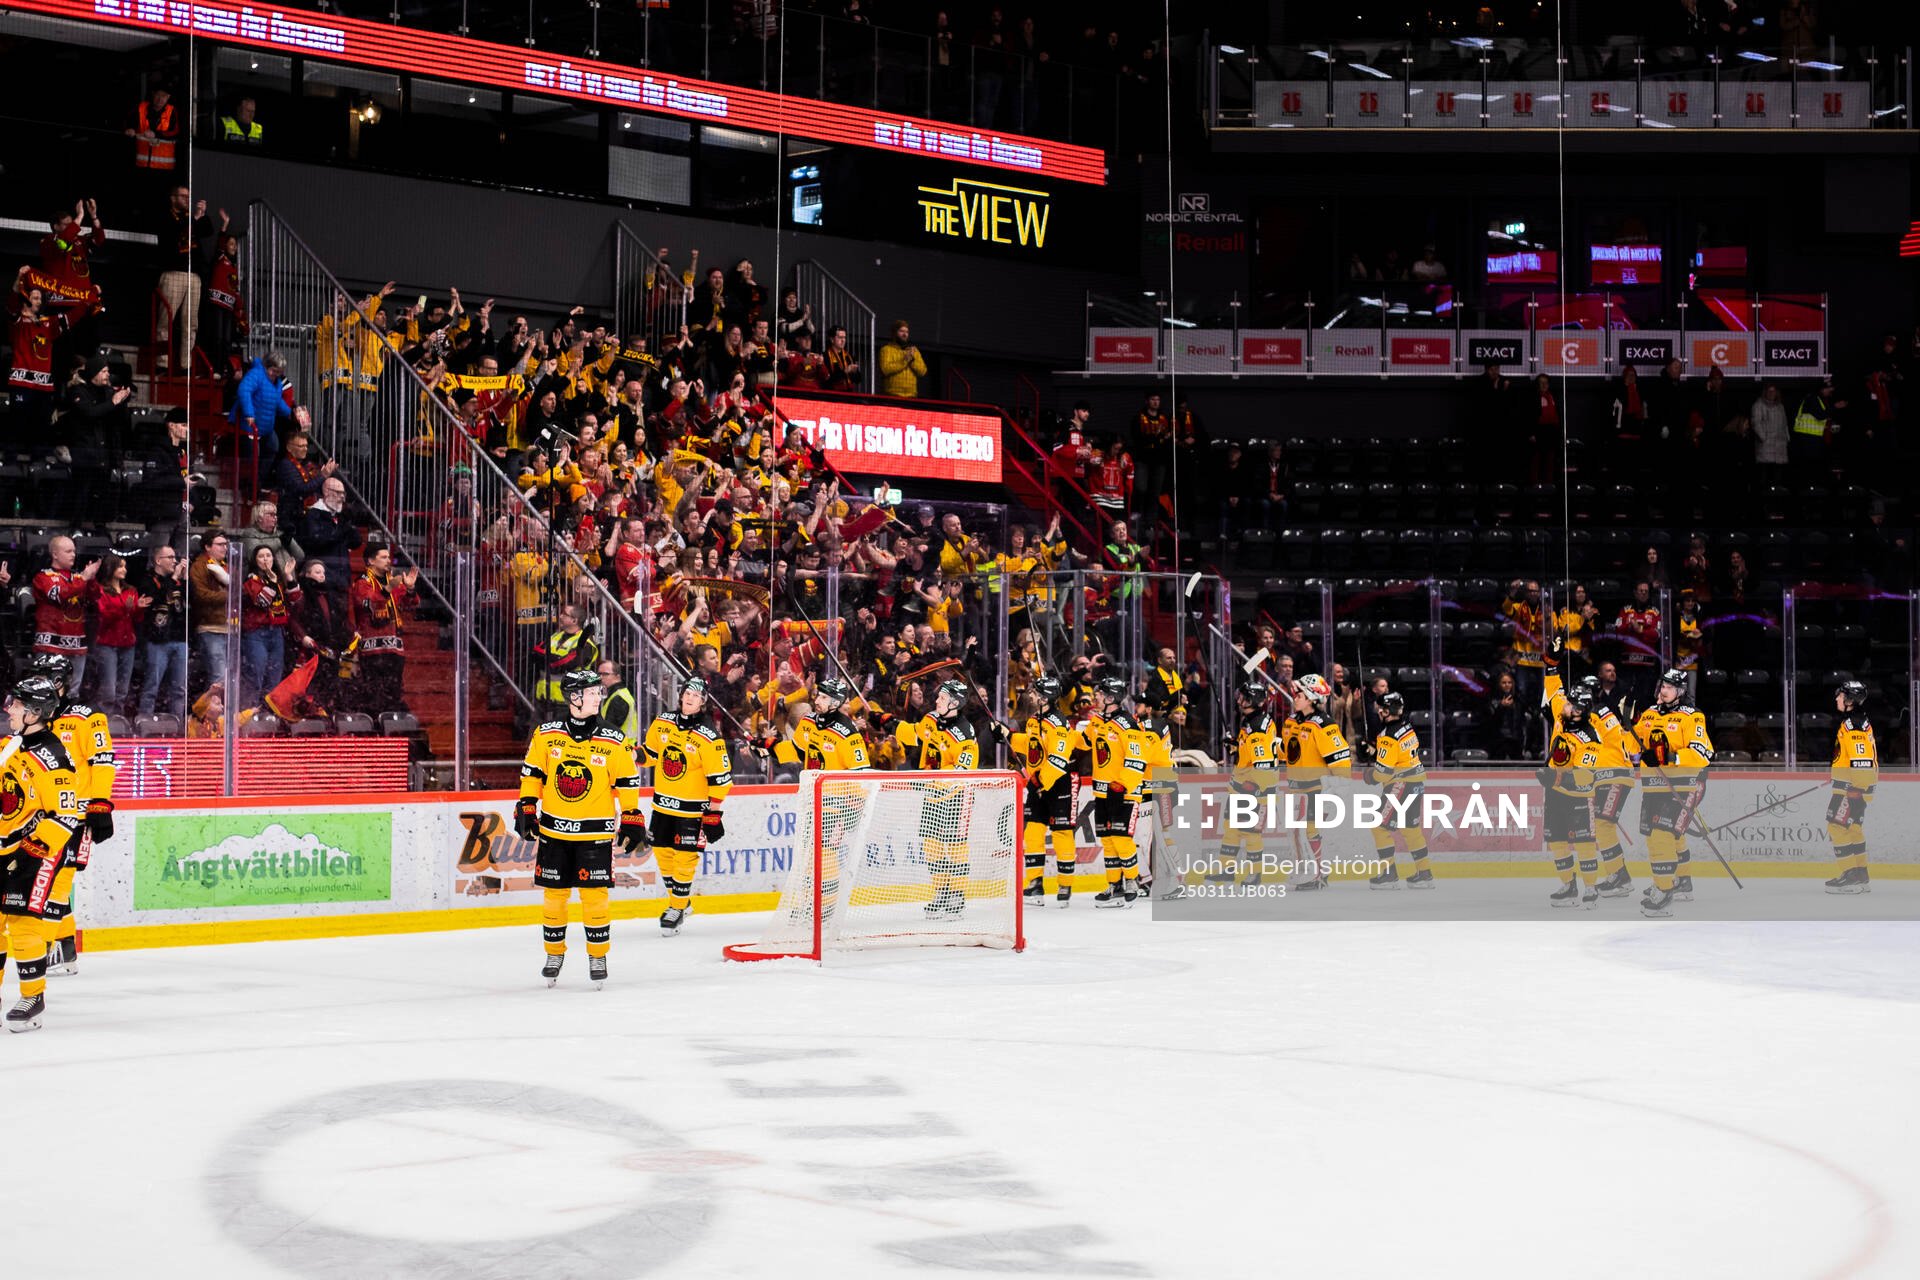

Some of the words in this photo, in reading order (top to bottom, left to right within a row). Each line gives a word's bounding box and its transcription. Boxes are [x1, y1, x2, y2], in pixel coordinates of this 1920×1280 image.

[1181, 195, 1208, 210] NR
[918, 200, 959, 236] THE
[959, 190, 1049, 248] VIEW
[1146, 213, 1191, 222] NORDIC
[1195, 213, 1244, 222] RENTAL
[1176, 231, 1245, 252] Renall
[1187, 345, 1226, 357] Renall
[1335, 345, 1375, 357] Renall
[1475, 347, 1516, 359] EXACT
[1625, 347, 1666, 359] EXACT
[1771, 348, 1812, 360] EXACT
[844, 423, 863, 452] VI
[864, 425, 903, 455] SOM
[931, 427, 994, 462] ÖREBRO
[72, 704, 91, 716] SSAB
[540, 721, 563, 731] SSAB
[698, 725, 717, 739] SSAB
[833, 722, 851, 736] SSAB
[601, 727, 624, 741] SSAB
[951, 726, 966, 742] SSAB
[1057, 741, 1065, 753] 3
[1129, 742, 1141, 755] 40
[1254, 746, 1265, 757] 86
[1379, 747, 1387, 759] 10
[1856, 743, 1865, 755] 15
[37, 747, 59, 770] SSAB
[958, 751, 973, 766] 96
[1582, 753, 1597, 767] 24
[1596, 770, 1614, 779] SSAB
[60, 792, 75, 809] 23
[659, 796, 681, 809] SSAB
[554, 820, 581, 832] SSAB
[1701, 823, 1833, 843] INGSTRÖM
[1742, 847, 1772, 856] GULD
[1776, 847, 1784, 856] &
[160, 846, 363, 889] Ångtvättbilen
